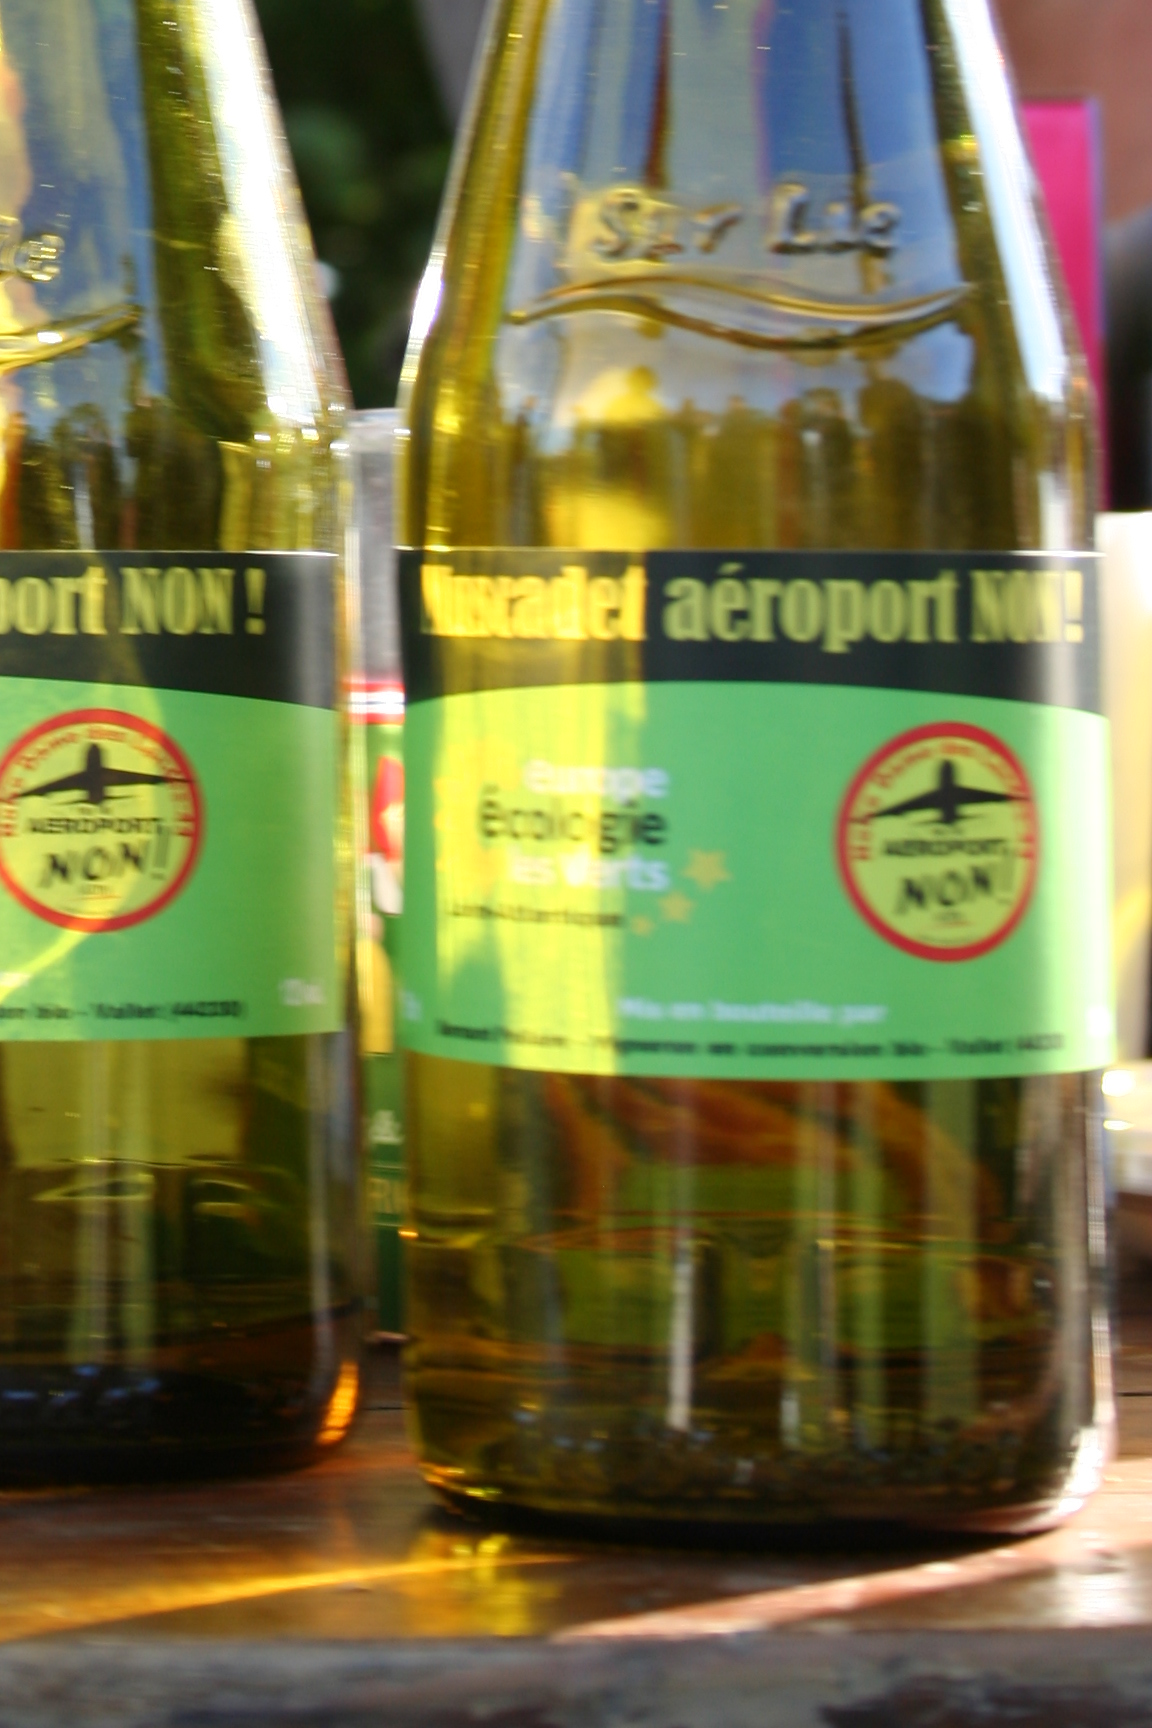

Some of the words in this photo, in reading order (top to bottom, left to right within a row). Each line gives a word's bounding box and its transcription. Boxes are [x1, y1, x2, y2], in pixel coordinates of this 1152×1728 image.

[769, 180, 903, 258] Lie
[662, 562, 959, 653] aéroport
[522, 758, 670, 803] europe
[478, 784, 667, 854] écologie
[556, 846, 670, 891] Verts
